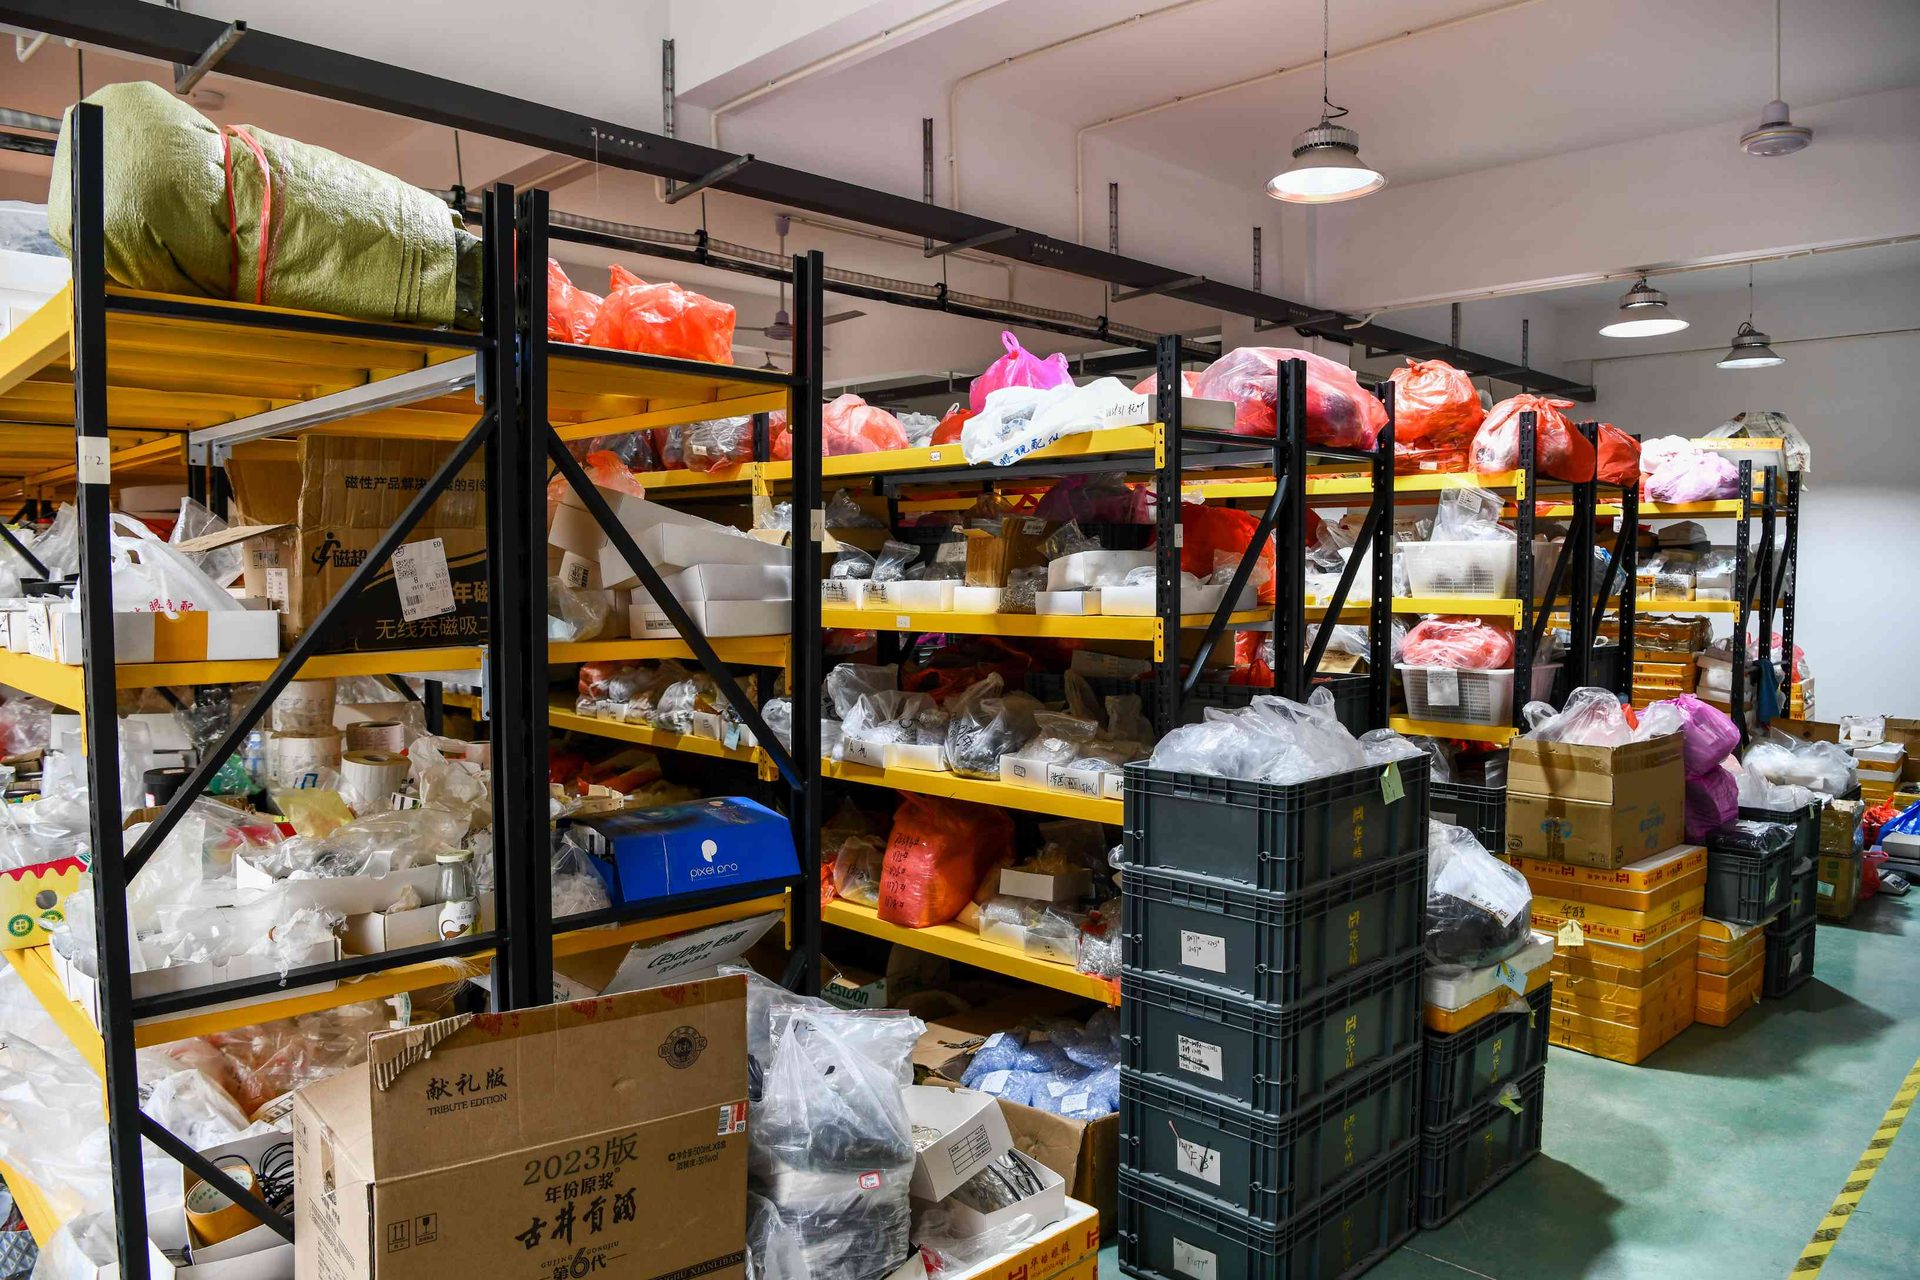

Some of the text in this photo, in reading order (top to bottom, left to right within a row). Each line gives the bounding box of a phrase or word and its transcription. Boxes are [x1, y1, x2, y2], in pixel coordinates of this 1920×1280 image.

[689, 866, 715, 879] pixel
[717, 861, 738, 874] pro
[426, 1067, 508, 1101] 献礼版
[427, 1093, 507, 1116] TRIBUTE EDITION
[523, 1132, 640, 1186] 2023版
[545, 1172, 614, 1204] 年份原浆
[540, 1240, 620, 1269] GUJING GONGJIU
